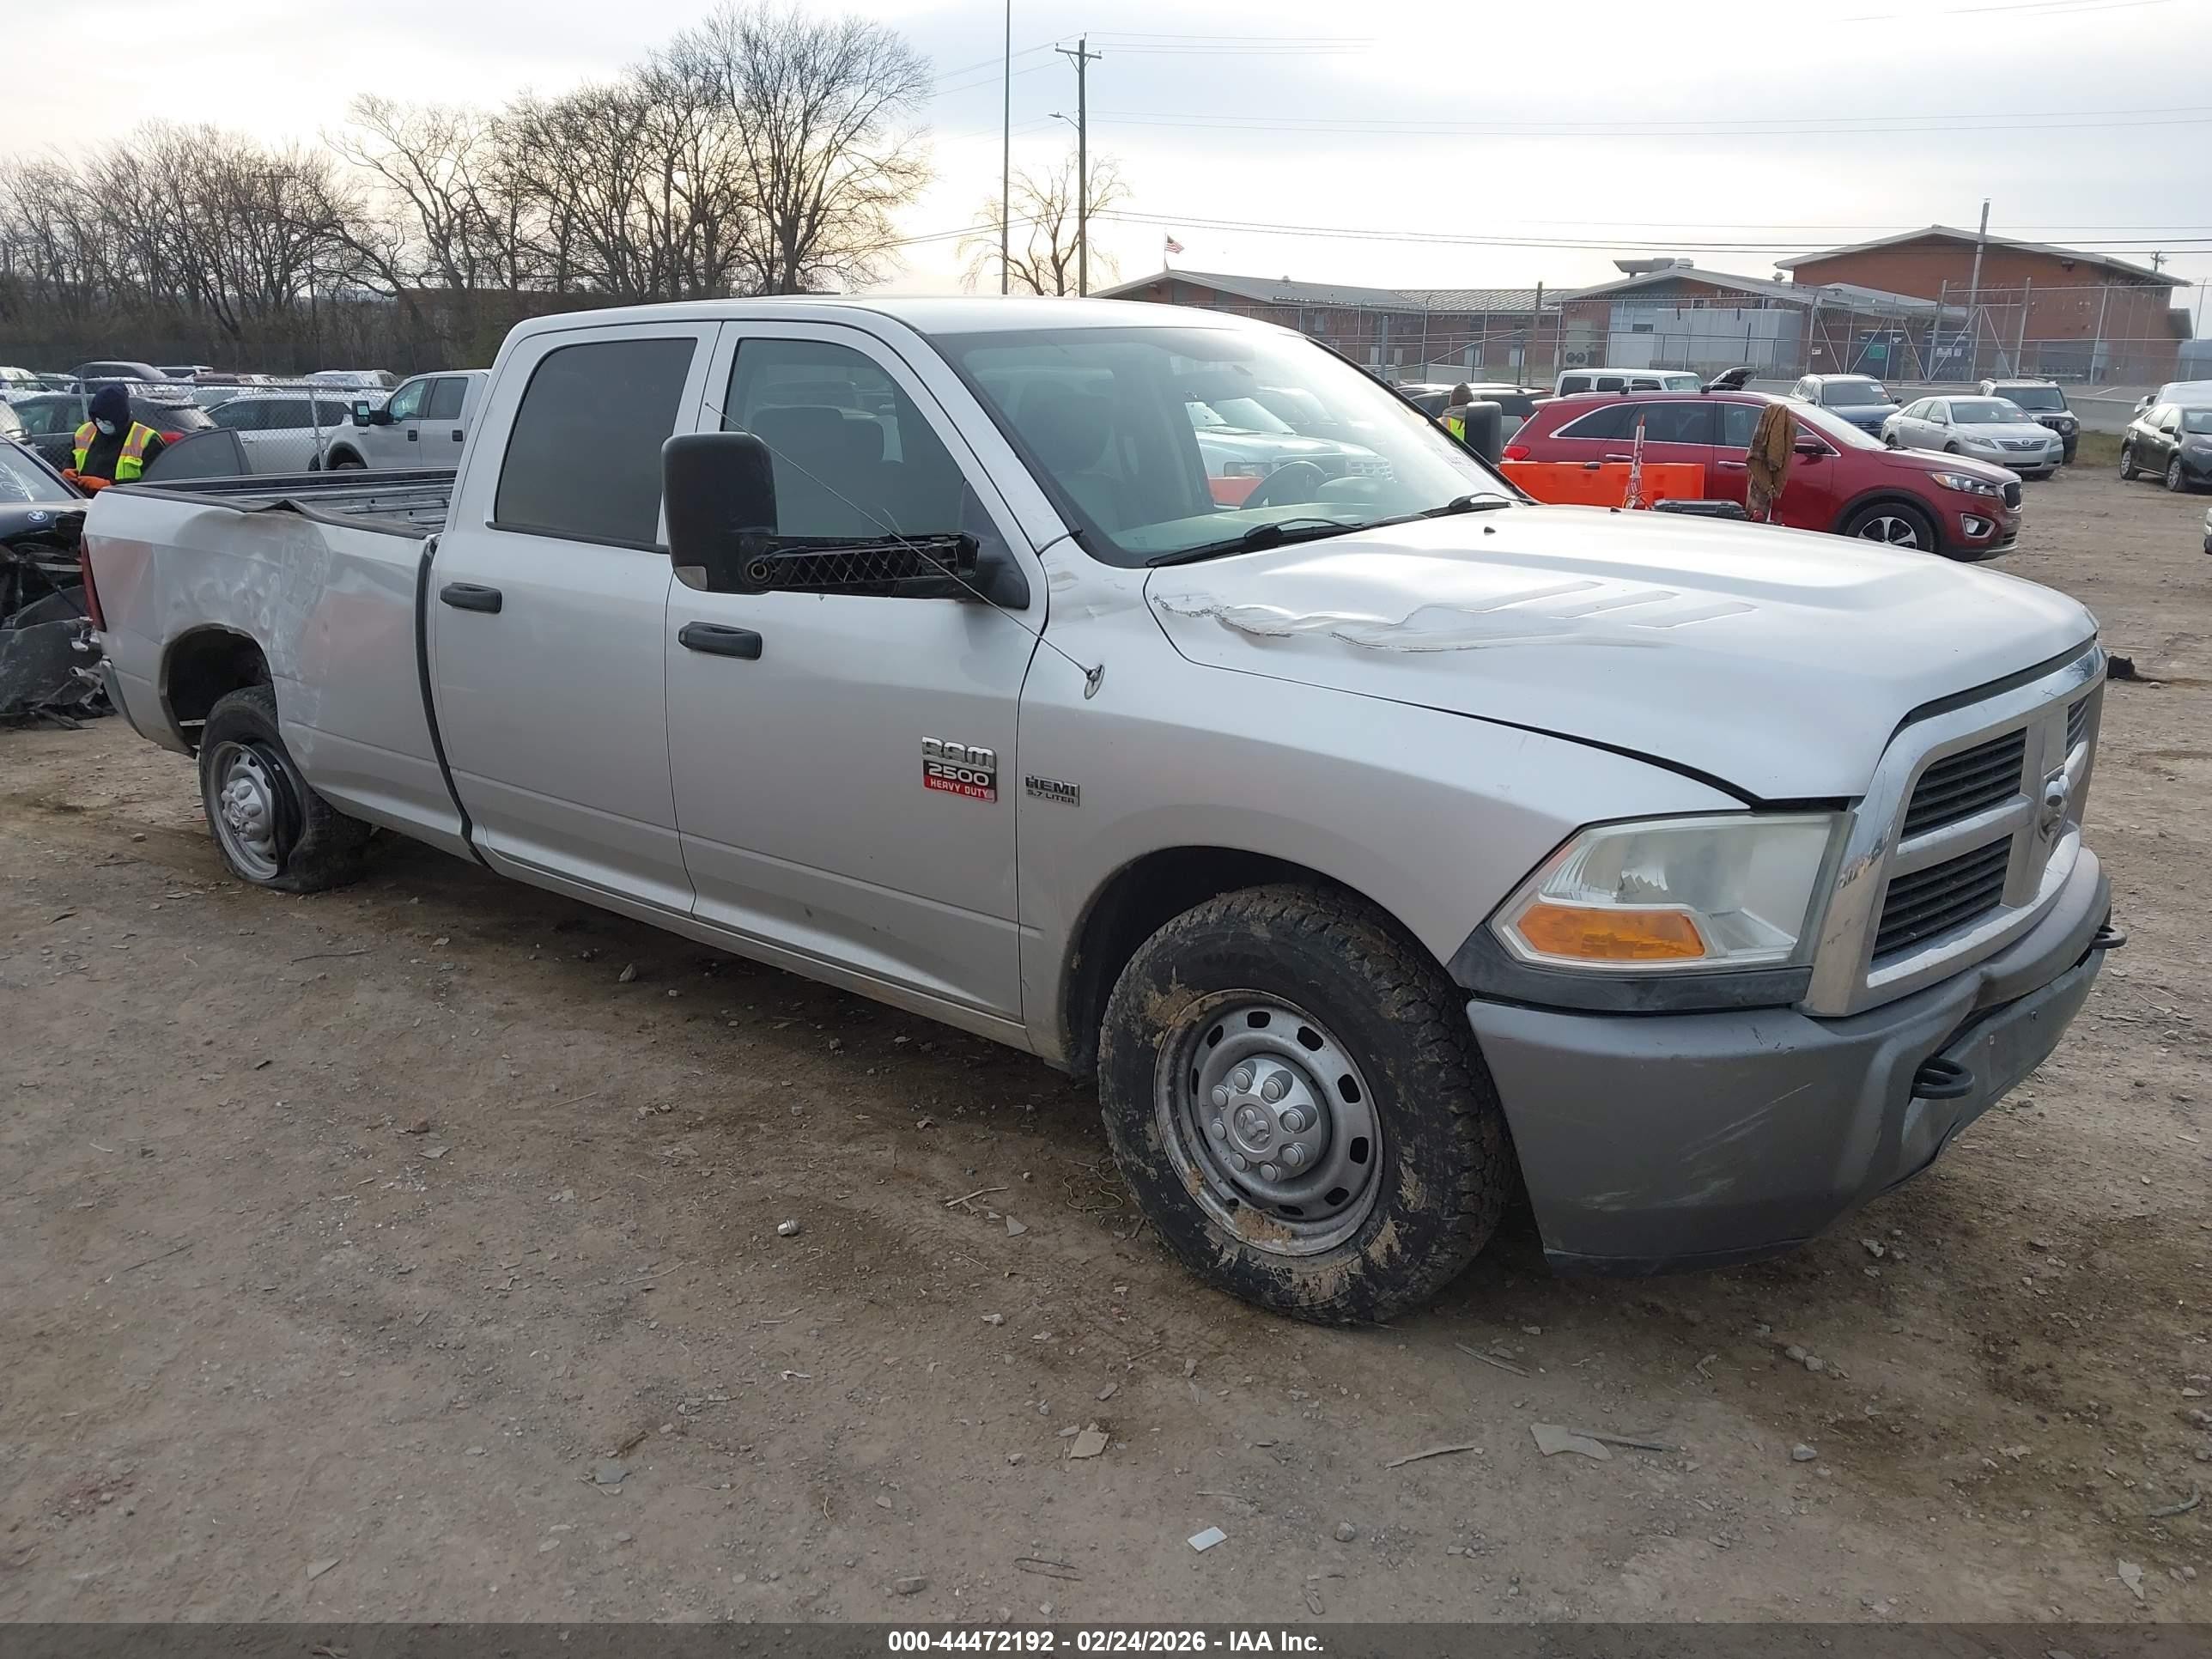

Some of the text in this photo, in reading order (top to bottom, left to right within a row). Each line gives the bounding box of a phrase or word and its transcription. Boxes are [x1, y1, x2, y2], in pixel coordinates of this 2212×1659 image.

[927, 763, 989, 787] 2500
[929, 778, 989, 799] HEAVY DUTY
[1024, 775, 1079, 799] HEMI
[1027, 788, 1075, 805] 5.7 LITER
